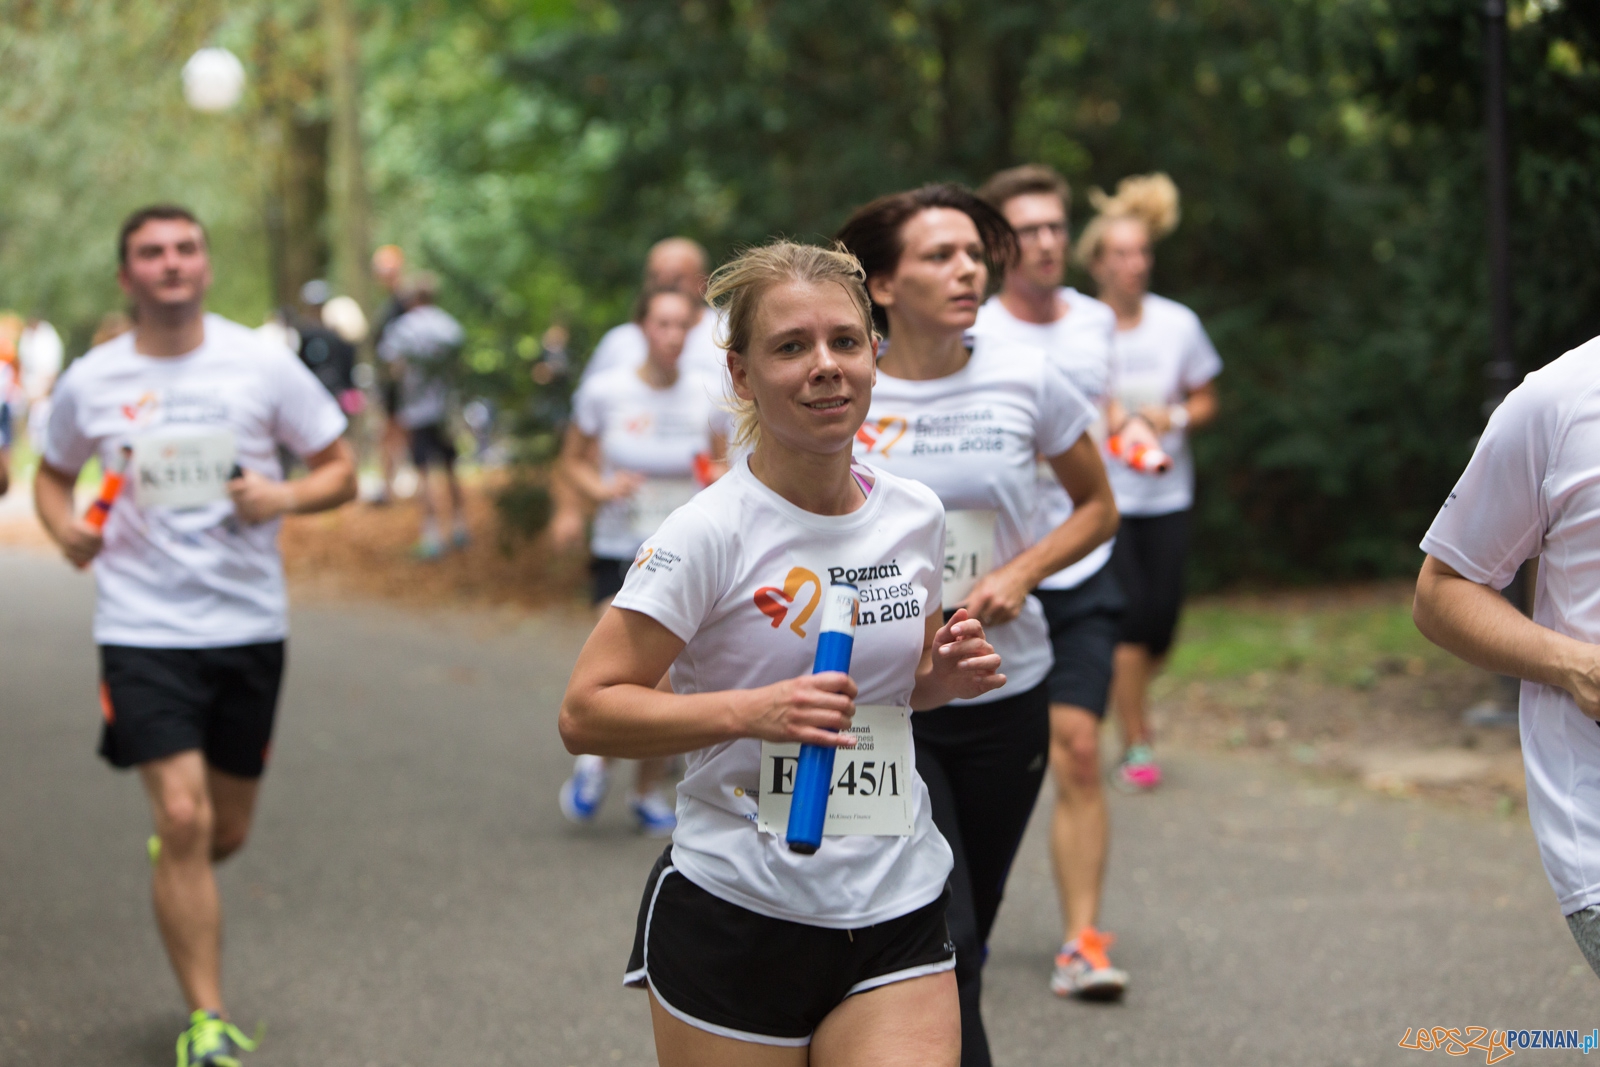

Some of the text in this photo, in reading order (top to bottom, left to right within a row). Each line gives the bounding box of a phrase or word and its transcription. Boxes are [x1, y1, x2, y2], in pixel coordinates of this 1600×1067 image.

[828, 559, 902, 585] Poznań
[859, 582, 914, 603] siness
[880, 599, 920, 623] 2016
[857, 742, 874, 751] 2016
